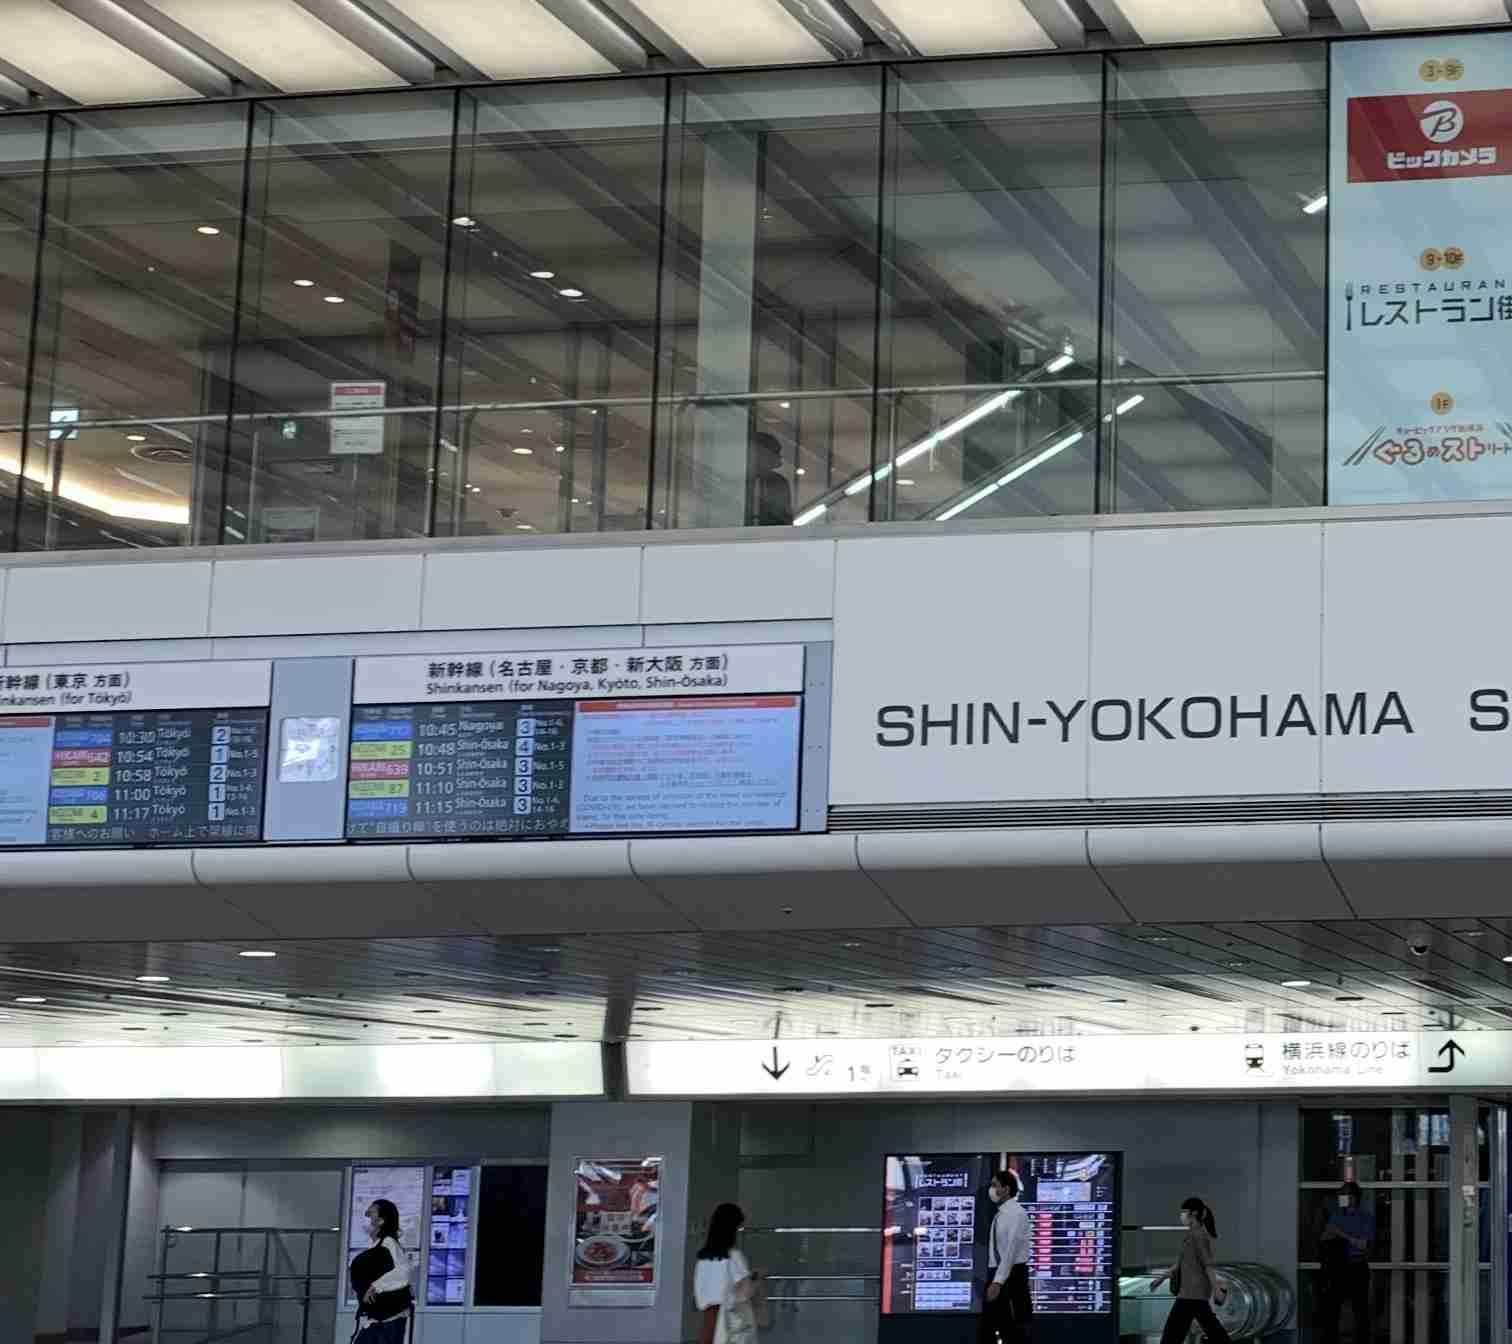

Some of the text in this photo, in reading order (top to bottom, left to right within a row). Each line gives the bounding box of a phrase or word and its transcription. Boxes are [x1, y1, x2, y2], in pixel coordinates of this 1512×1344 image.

[1386, 144, 1497, 169] ビックカメラ
[428, 661, 483, 678] 新幹線
[427, 682, 503, 695] Shinkansen
[537, 679, 593, 694] Nagoya,
[876, 692, 1414, 747] SHIN-YOKOHAMA
[115, 768, 152, 782] 10:58
[417, 762, 453, 776] 10:51
[114, 788, 151, 801] 11:00
[416, 780, 454, 795] 11:10
[113, 807, 150, 819] 11:17
[415, 800, 453, 814] 11:15
